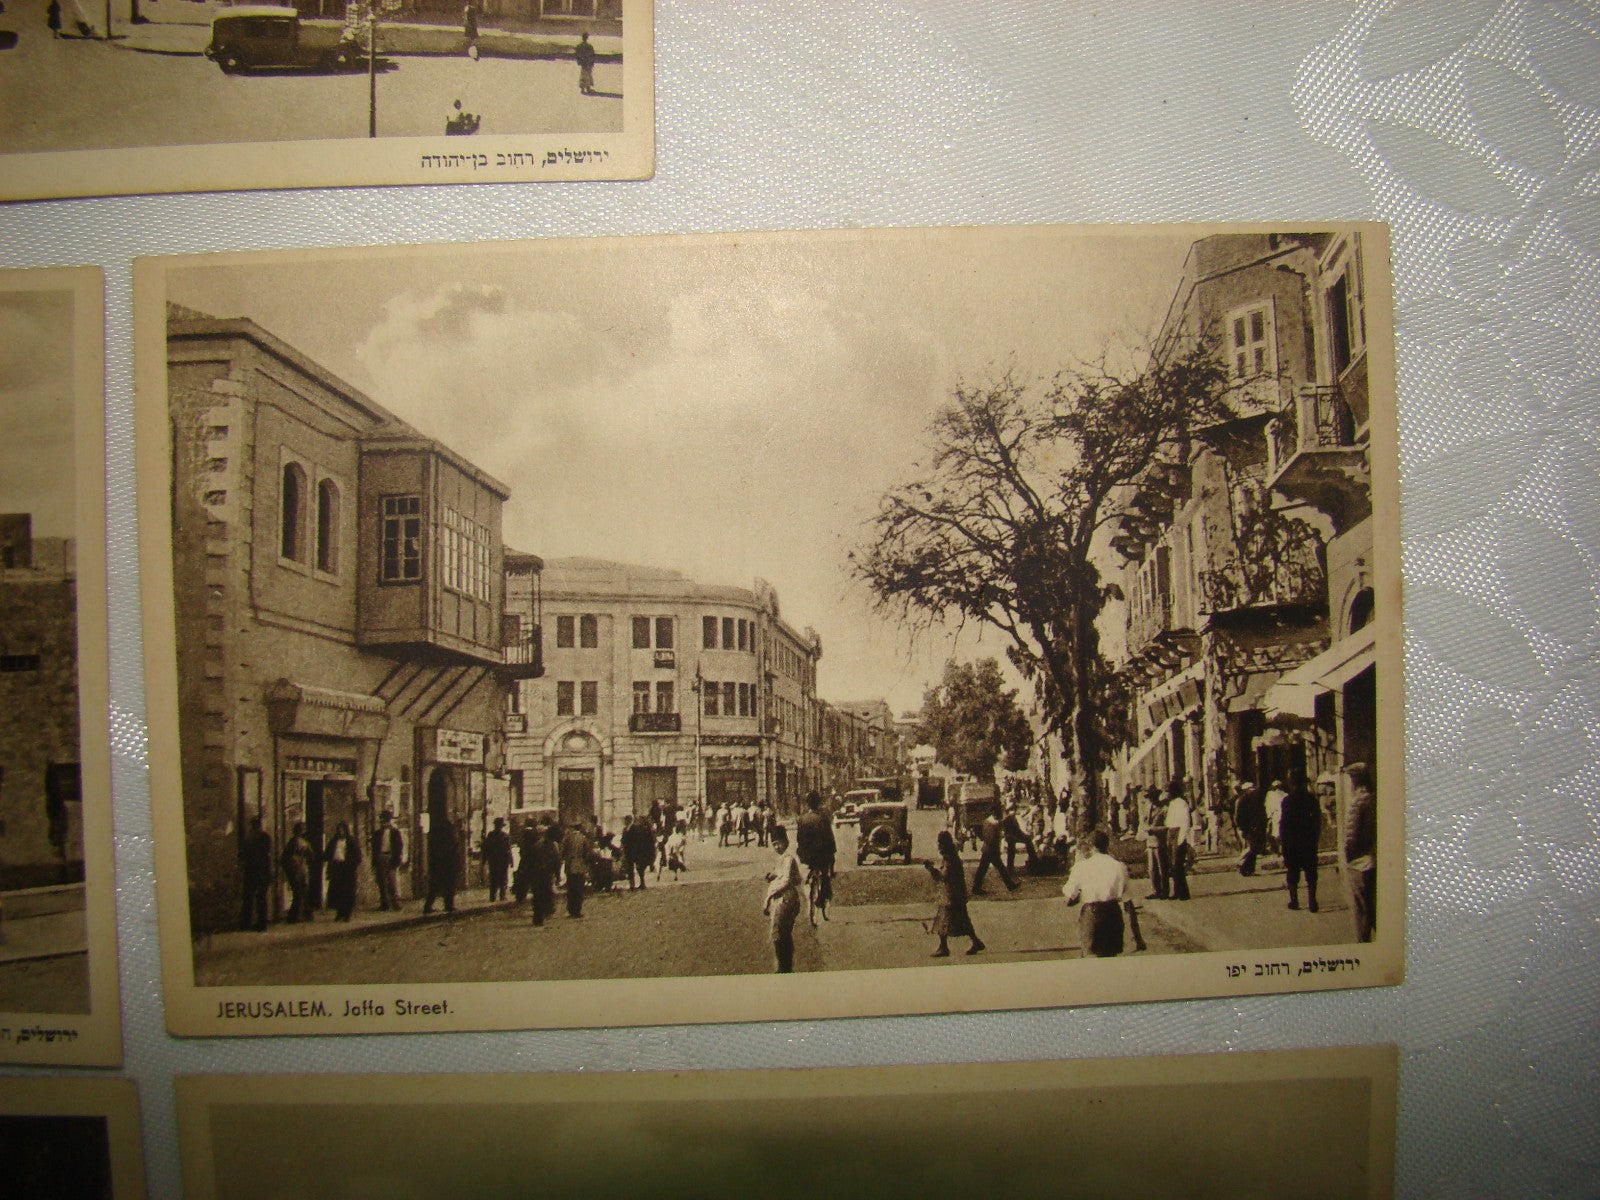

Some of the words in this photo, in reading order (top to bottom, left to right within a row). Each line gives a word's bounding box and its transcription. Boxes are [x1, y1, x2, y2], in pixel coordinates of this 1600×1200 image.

[497, 153, 534, 166] רחוב
[541, 148, 609, 168] ירושלים,
[1226, 964, 1247, 977] יפו
[1254, 962, 1290, 976] רחוב
[1298, 957, 1360, 976] ירושלים,
[343, 1000, 385, 1017] Jaffa
[395, 999, 454, 1016] Street.
